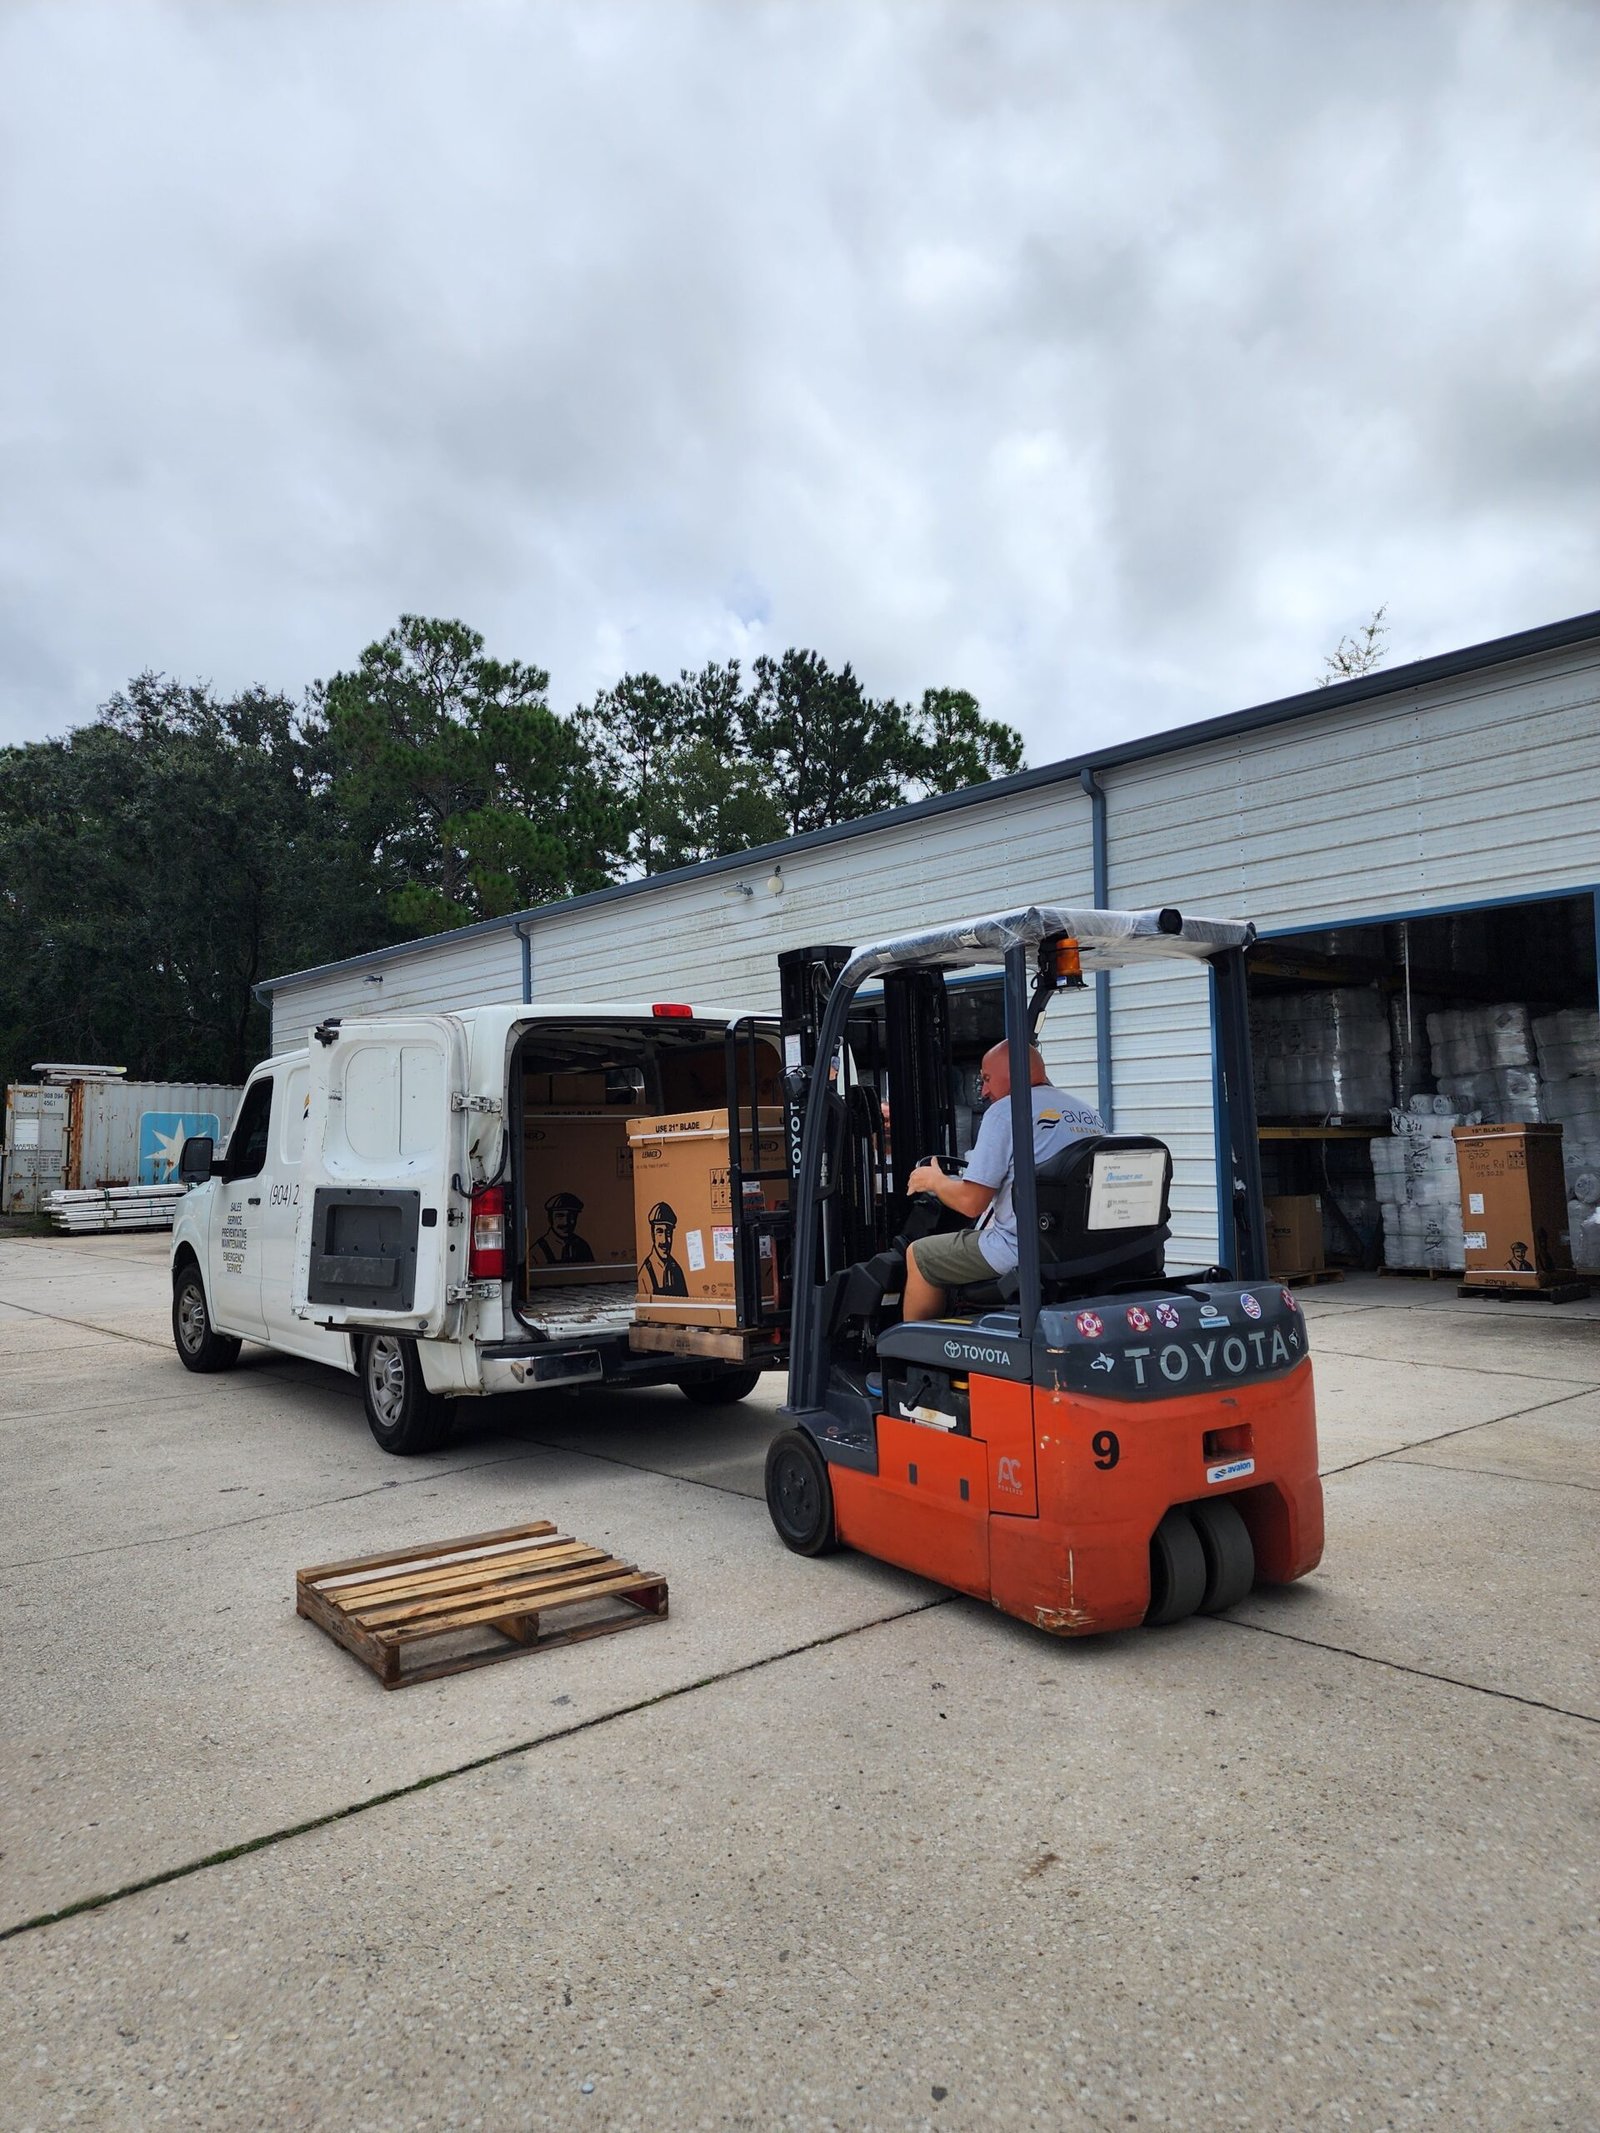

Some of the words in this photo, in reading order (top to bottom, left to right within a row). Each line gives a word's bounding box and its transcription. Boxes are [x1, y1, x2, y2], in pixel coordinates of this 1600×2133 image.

[1061, 1109, 1107, 1130] avalo
[655, 1125, 668, 1133] USE
[668, 1124, 679, 1132] 21"
[680, 1122, 700, 1131] BLADE
[789, 1100, 802, 1179] TOYOT
[269, 1182, 292, 1207] (904)
[292, 1184, 300, 1205] 2
[230, 1202, 243, 1212] SALES
[227, 1215, 243, 1226] SERVICE
[221, 1228, 248, 1239] PREVENTATIVE
[221, 1239, 247, 1250] MAINTENANCE
[223, 1251, 245, 1263] EMERGENCY
[226, 1263, 242, 1274] SERVICE
[961, 1344, 1011, 1366] TOYOTA
[1124, 1329, 1290, 1385] TOYOTA
[1091, 1430, 1121, 1471] 9
[1226, 1461, 1252, 1474] avalon
